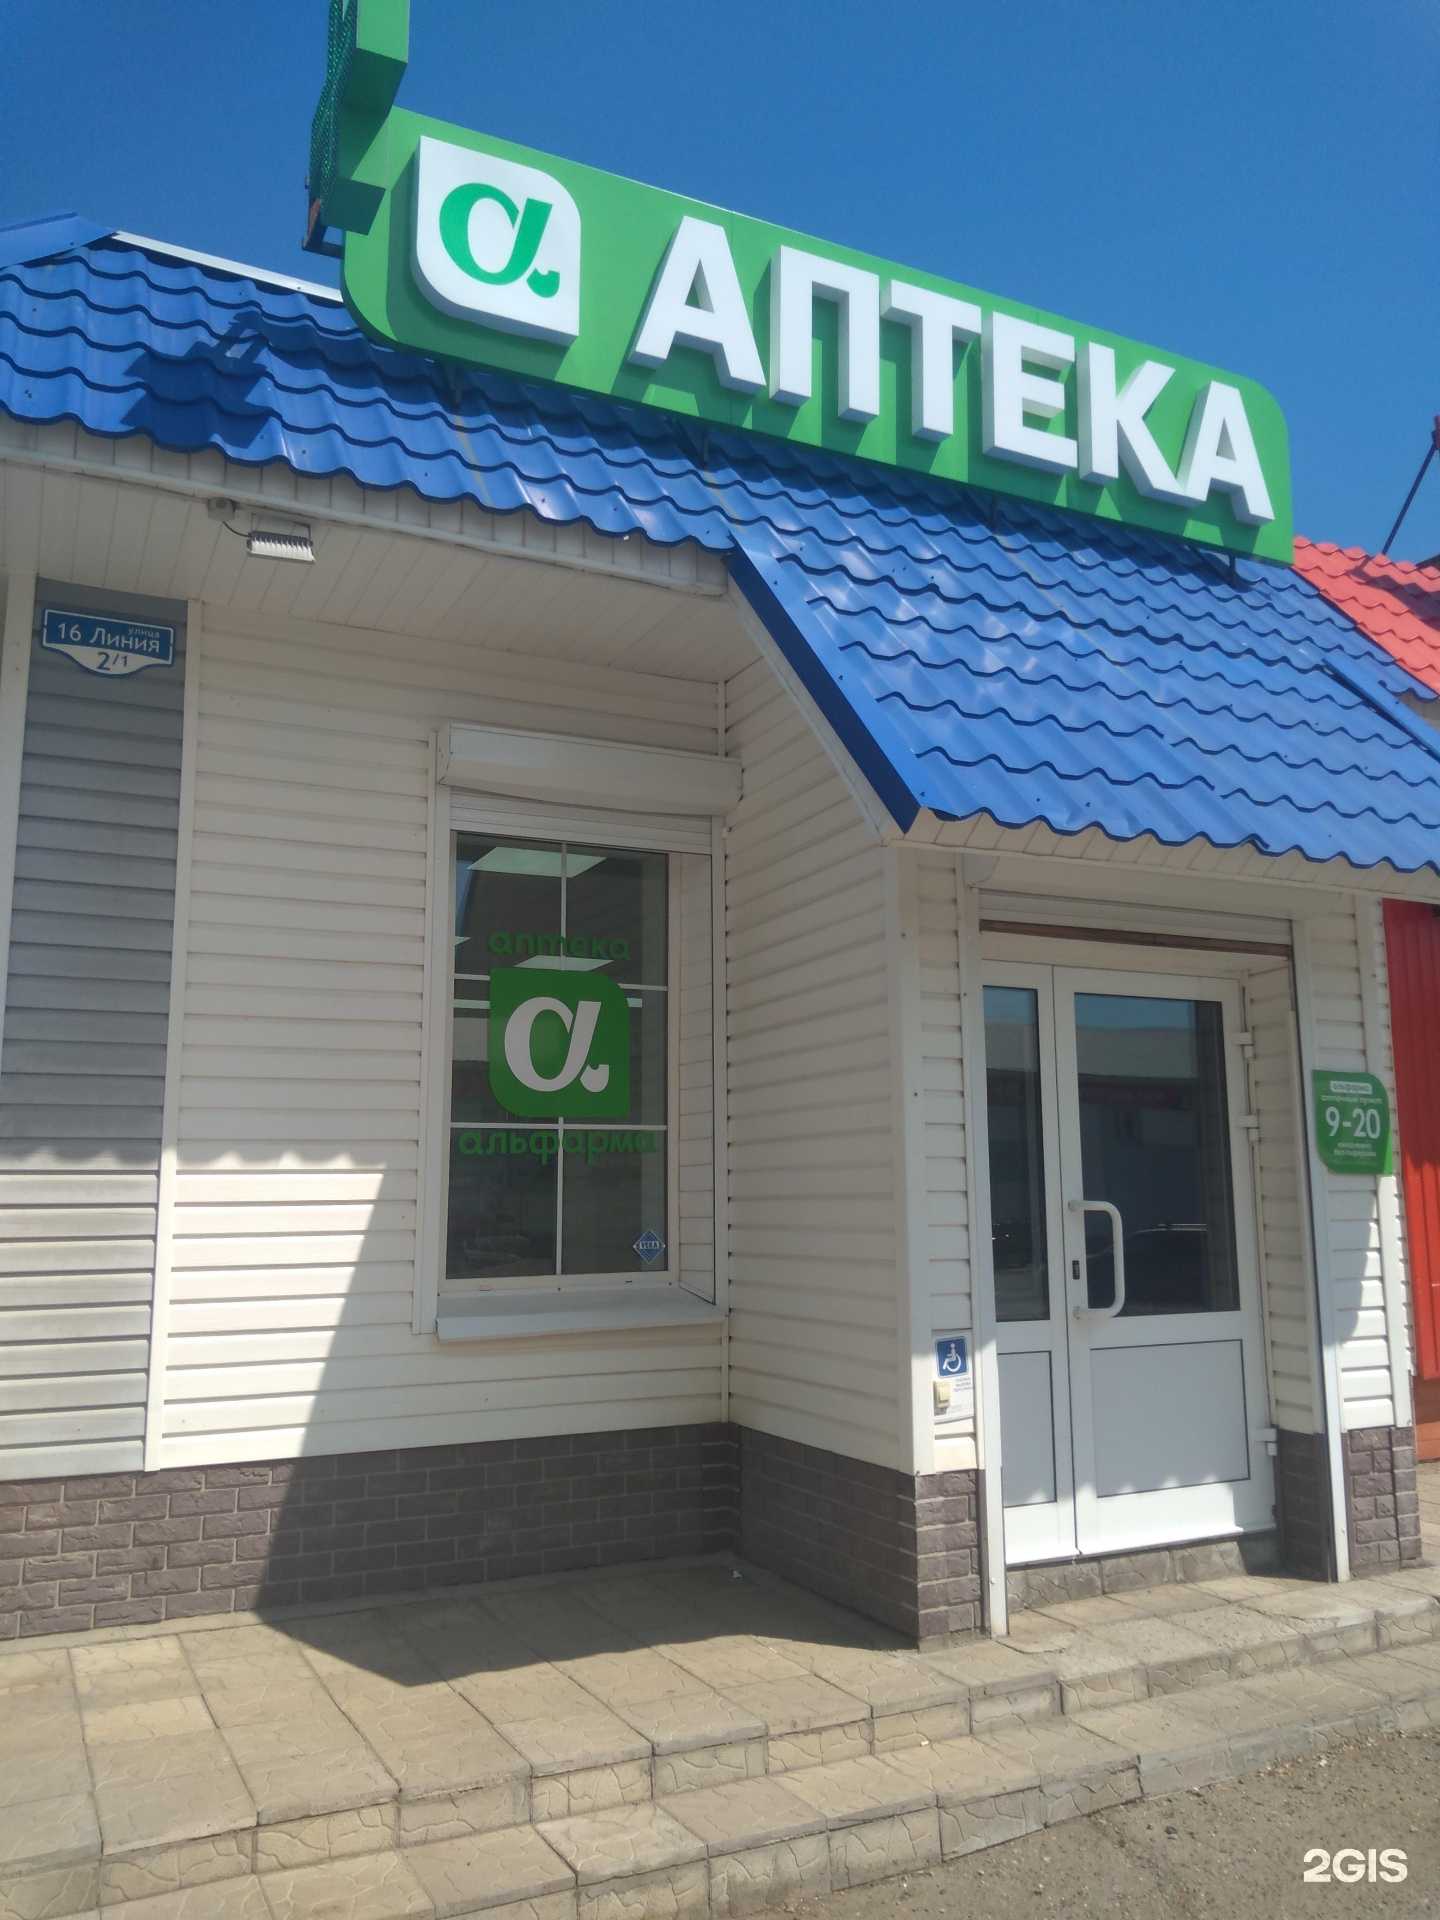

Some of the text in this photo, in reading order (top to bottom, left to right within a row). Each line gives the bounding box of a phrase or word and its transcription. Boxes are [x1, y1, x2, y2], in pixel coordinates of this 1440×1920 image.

[629, 216, 1275, 524] АПТЕКА
[57, 623, 160, 653] 16 Линия
[97, 652, 129, 671] 2/1
[488, 931, 631, 960] аптека
[458, 1131, 657, 1166] альфарма
